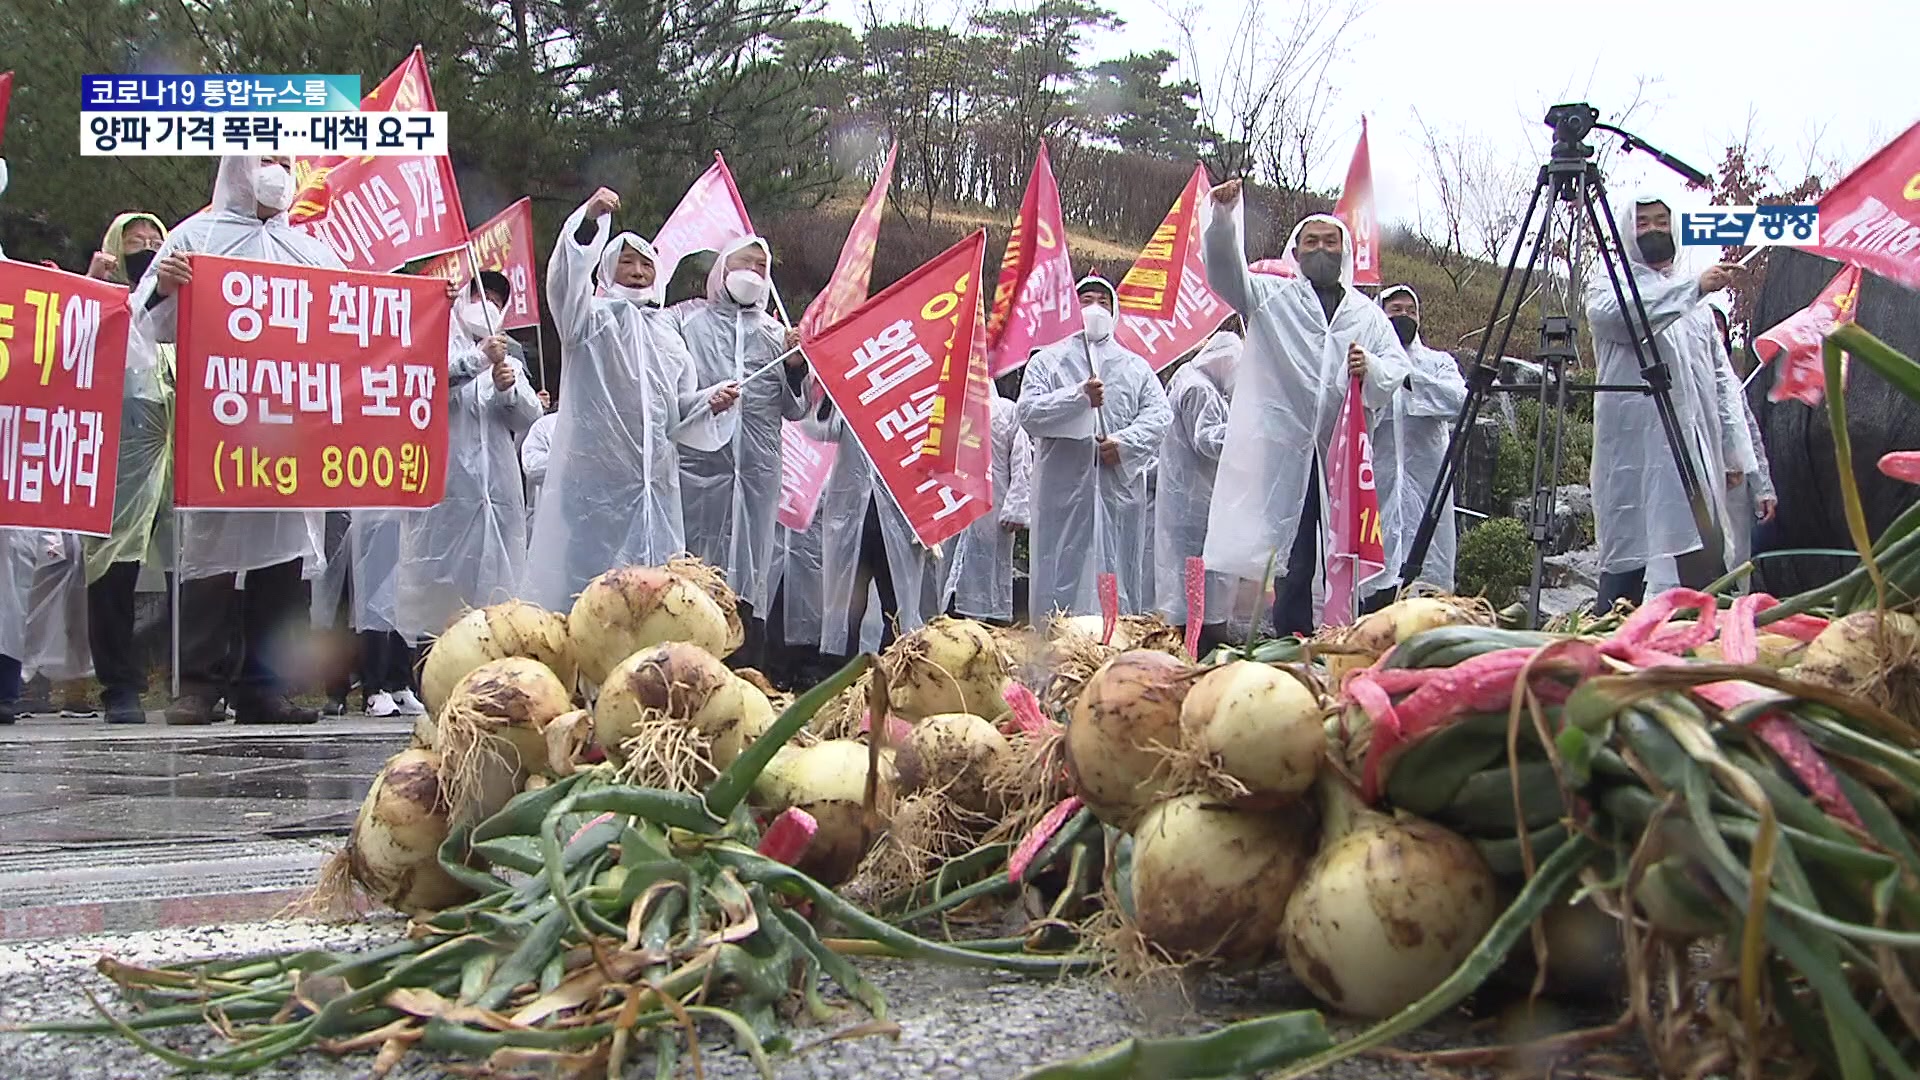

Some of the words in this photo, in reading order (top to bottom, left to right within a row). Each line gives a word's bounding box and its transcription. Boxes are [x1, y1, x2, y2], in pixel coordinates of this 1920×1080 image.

[221, 271, 314, 344] 양파
[328, 281, 412, 348] 최저
[204, 355, 343, 425] 생산비
[361, 364, 436, 430] 보장
[214, 440, 298, 495] (1kg
[321, 442, 429, 495] 800원)
